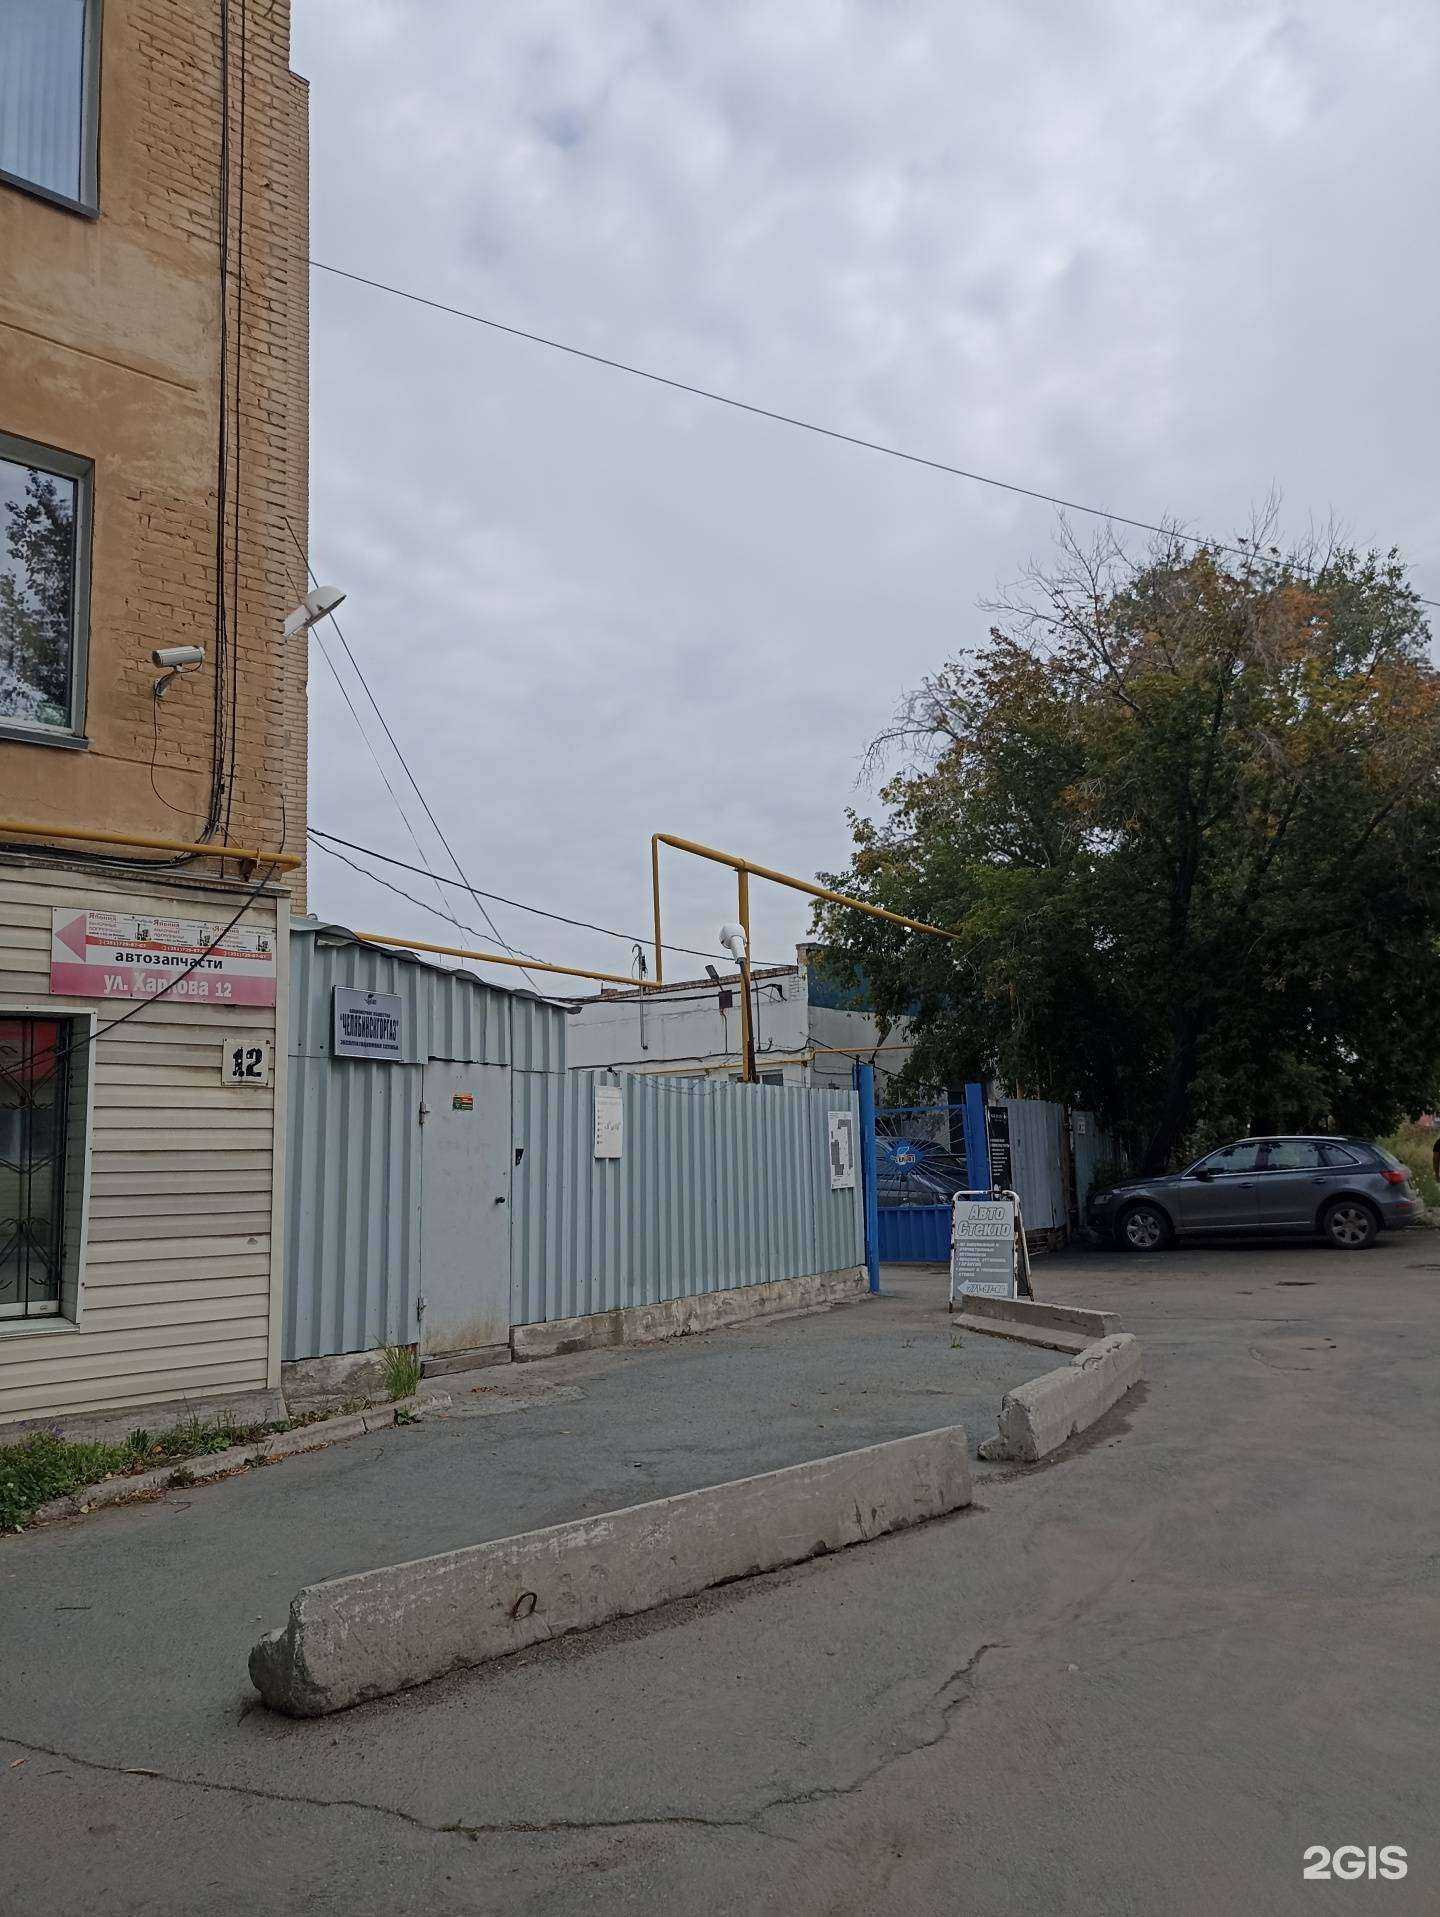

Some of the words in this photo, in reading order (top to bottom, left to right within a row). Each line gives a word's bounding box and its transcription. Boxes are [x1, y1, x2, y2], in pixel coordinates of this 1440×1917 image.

[153, 919, 180, 929] Япония
[213, 925, 239, 934] Япния
[115, 952, 223, 969] автозапчасти
[103, 974, 128, 993] ул.
[215, 982, 232, 998] 12
[232, 1047, 263, 1078] 12
